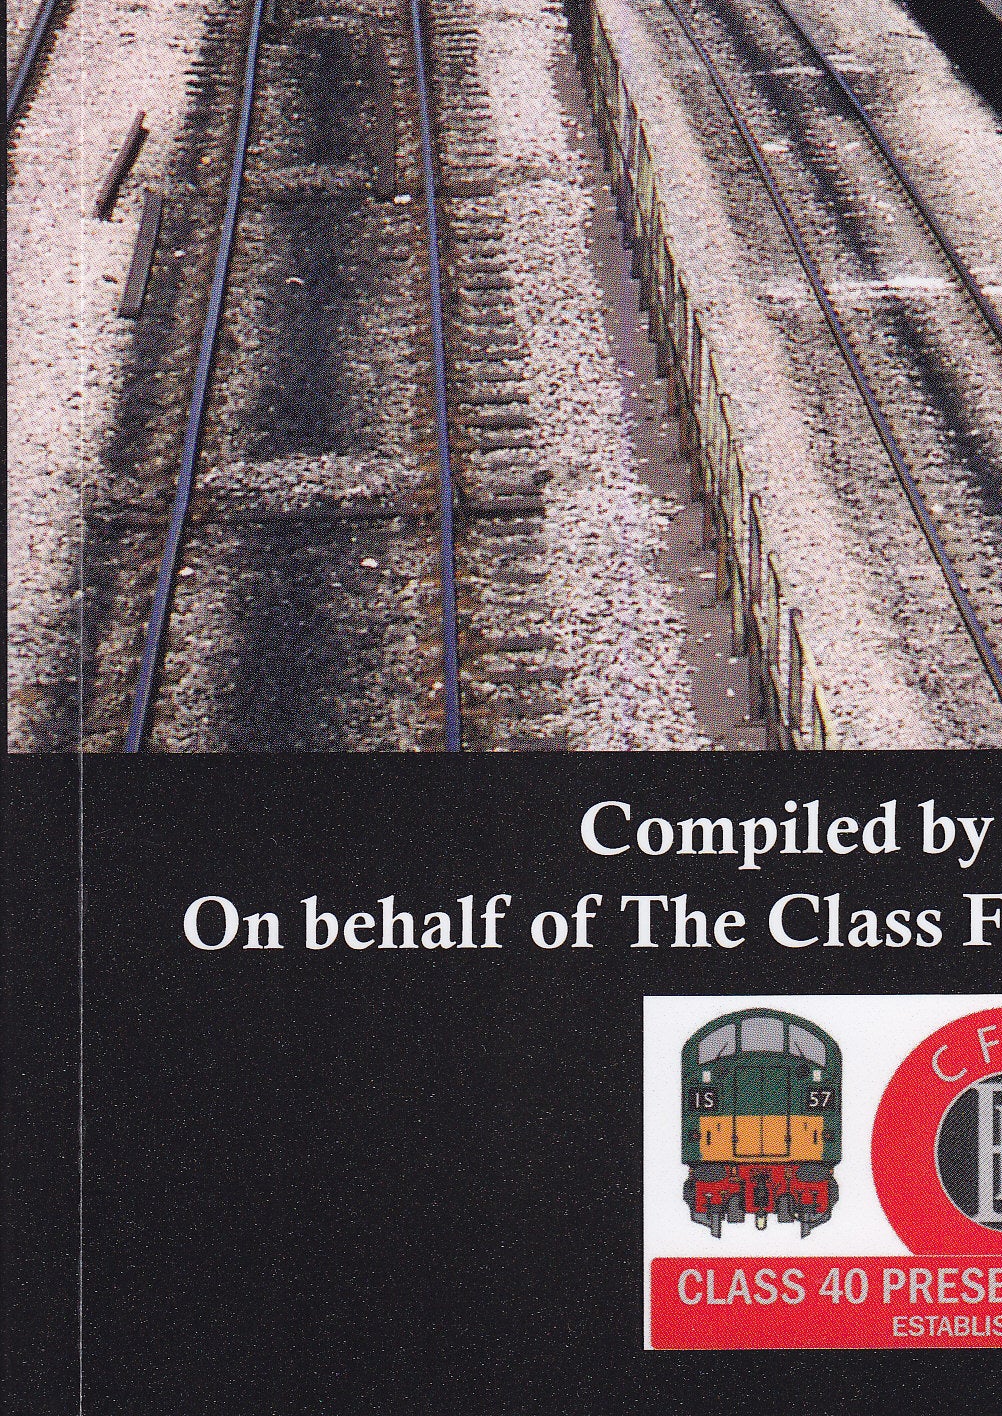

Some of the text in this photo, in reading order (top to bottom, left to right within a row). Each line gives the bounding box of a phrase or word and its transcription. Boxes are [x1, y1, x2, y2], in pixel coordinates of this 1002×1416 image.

[582, 801, 901, 871] Compiled
[920, 801, 995, 869] by
[185, 897, 284, 951] On
[303, 895, 512, 950] behalf
[532, 895, 603, 949] of
[622, 895, 746, 949] The
[770, 894, 943, 948] Class
[808, 1091, 832, 1108] 57
[678, 1269, 806, 1306] CLASS
[820, 1268, 869, 1305] 40
